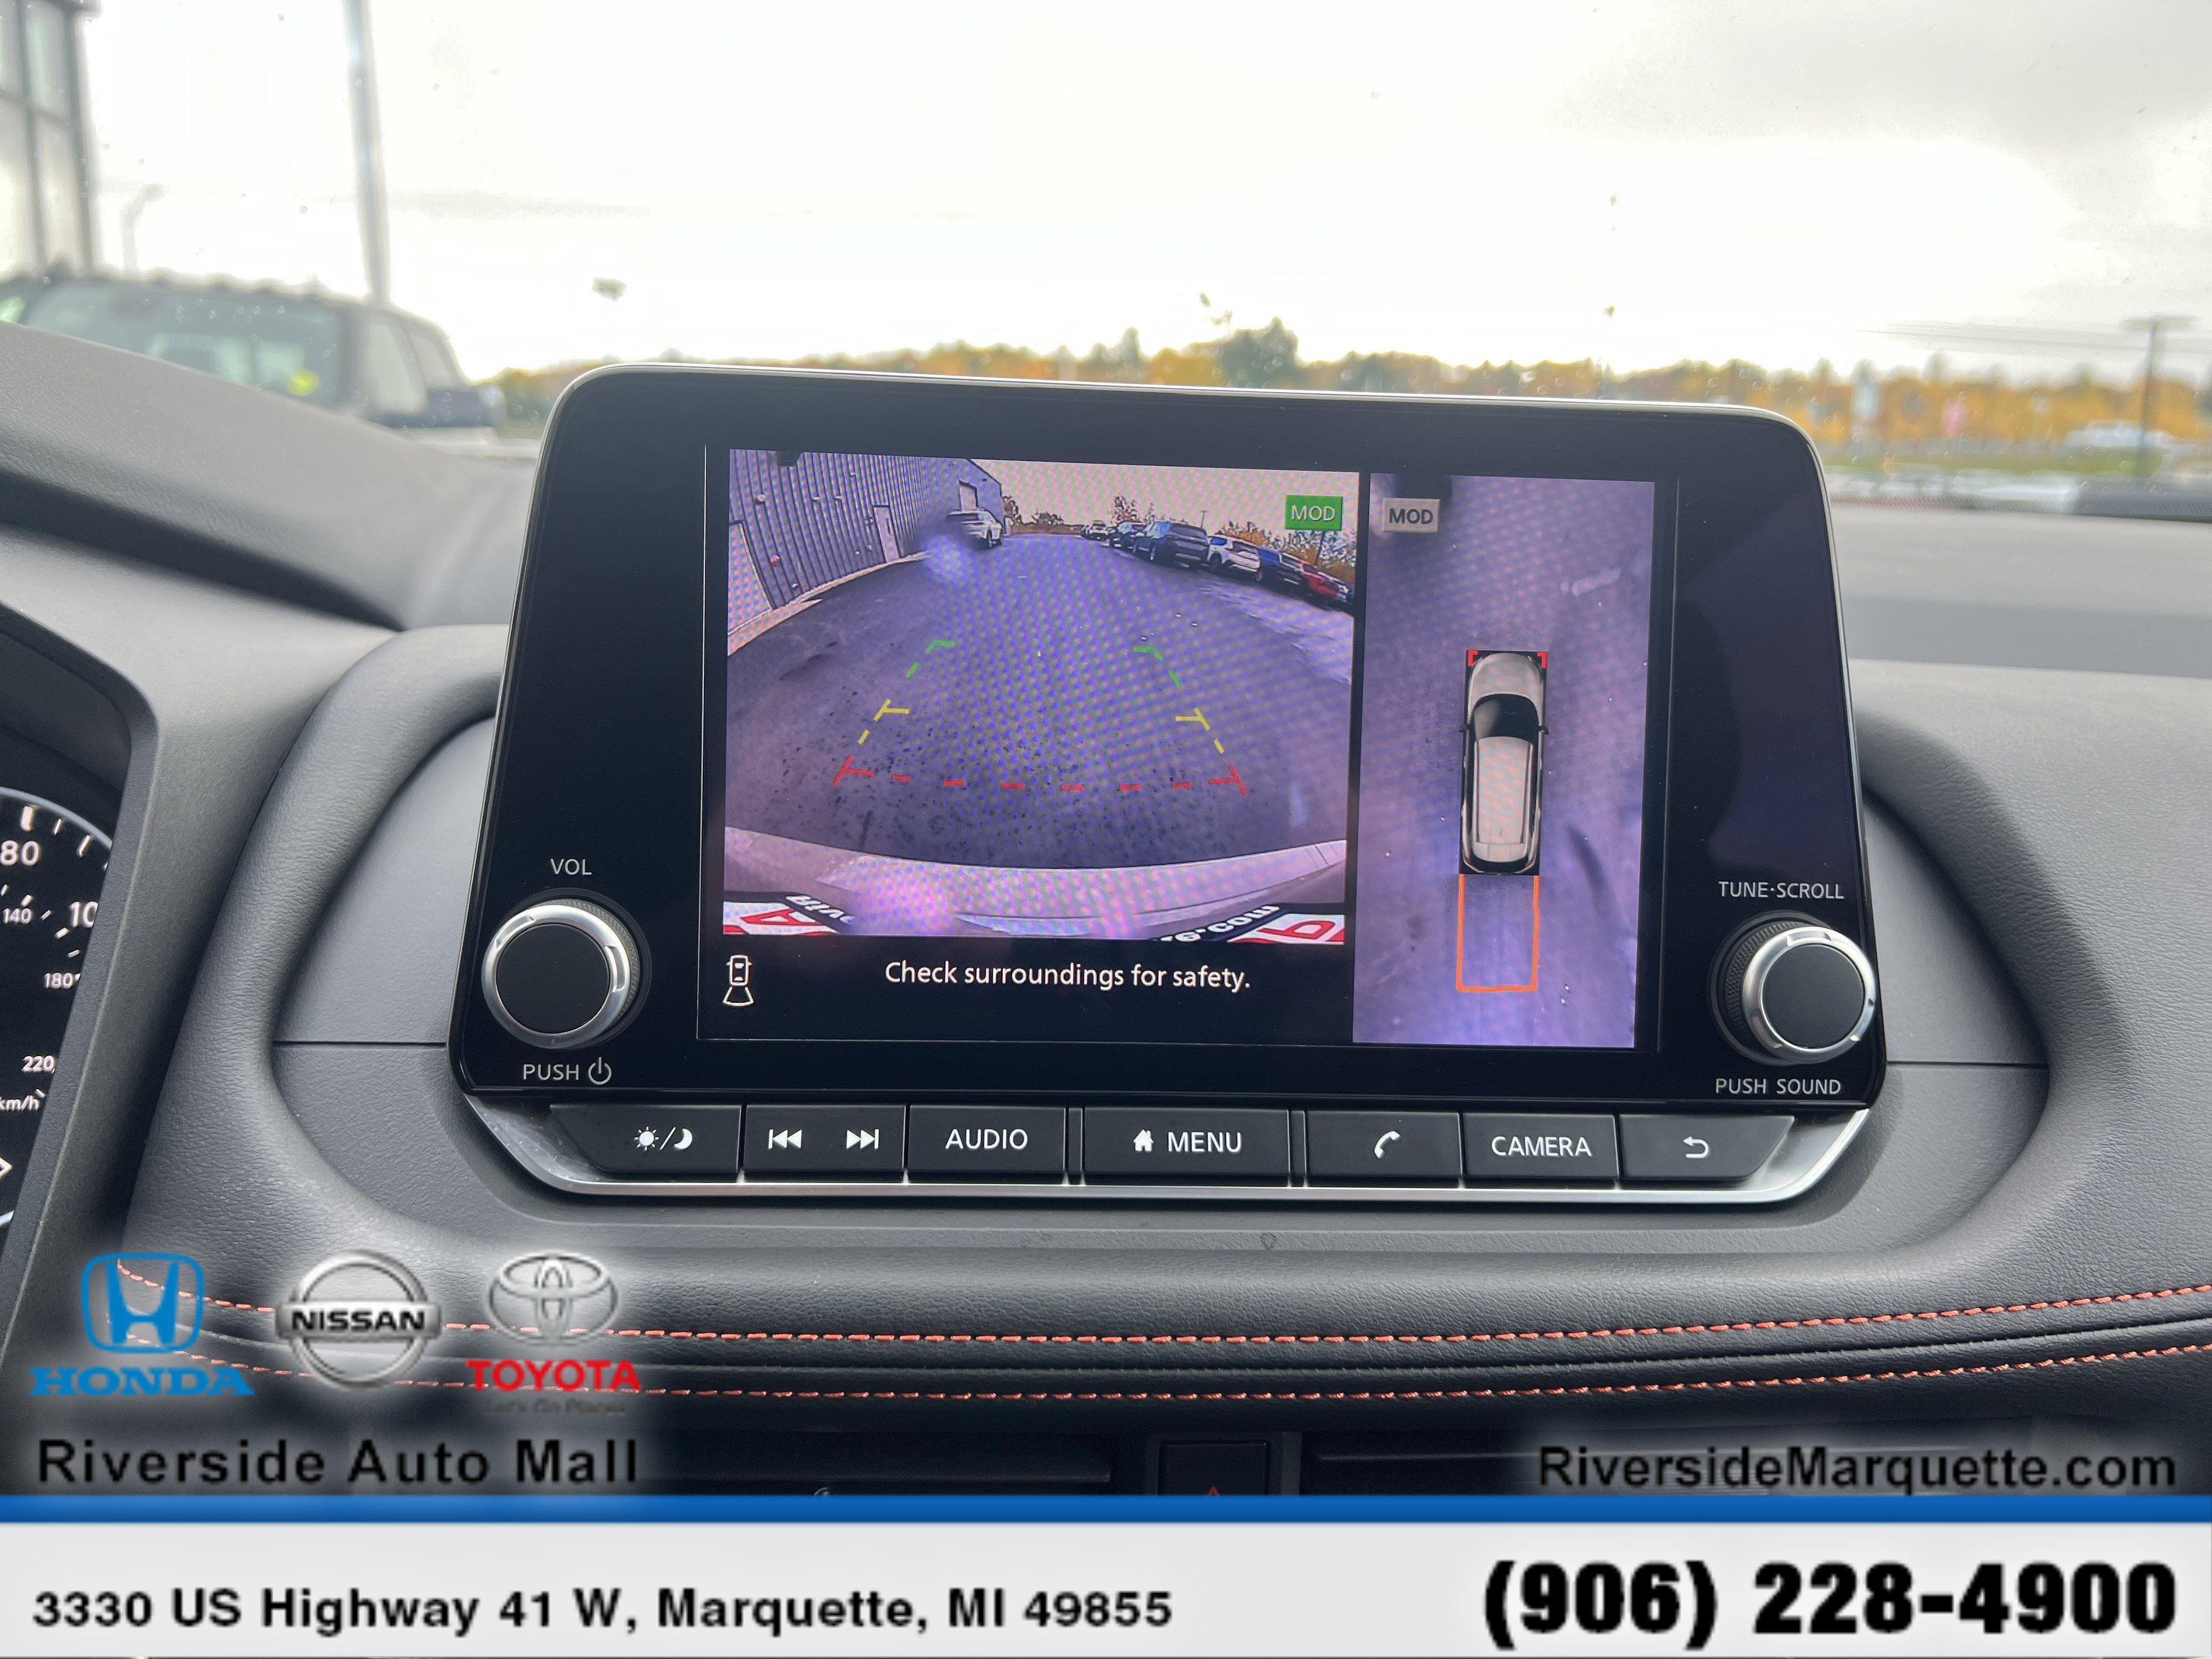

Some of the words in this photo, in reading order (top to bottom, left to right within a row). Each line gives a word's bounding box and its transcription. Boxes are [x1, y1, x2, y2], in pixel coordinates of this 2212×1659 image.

[1291, 505, 1336, 522] MOD
[1389, 508, 1434, 525] MOD
[0, 840, 40, 866] 80
[550, 859, 592, 876] VOL
[3, 907, 32, 924] 140
[43, 972, 73, 988] 180
[885, 960, 957, 984] Check
[964, 962, 1125, 992] surroundings
[1131, 963, 1167, 988] for
[1172, 967, 1251, 994] safety.
[21, 1055, 54, 1072] 220
[523, 1064, 579, 1081] PUSH
[1716, 1078, 1767, 1094] PUSH
[1776, 1079, 1842, 1095] SOUND
[945, 1128, 1029, 1151] AUDIO
[1167, 1131, 1243, 1154] MENU
[1491, 1136, 1593, 1158] CAMERA
